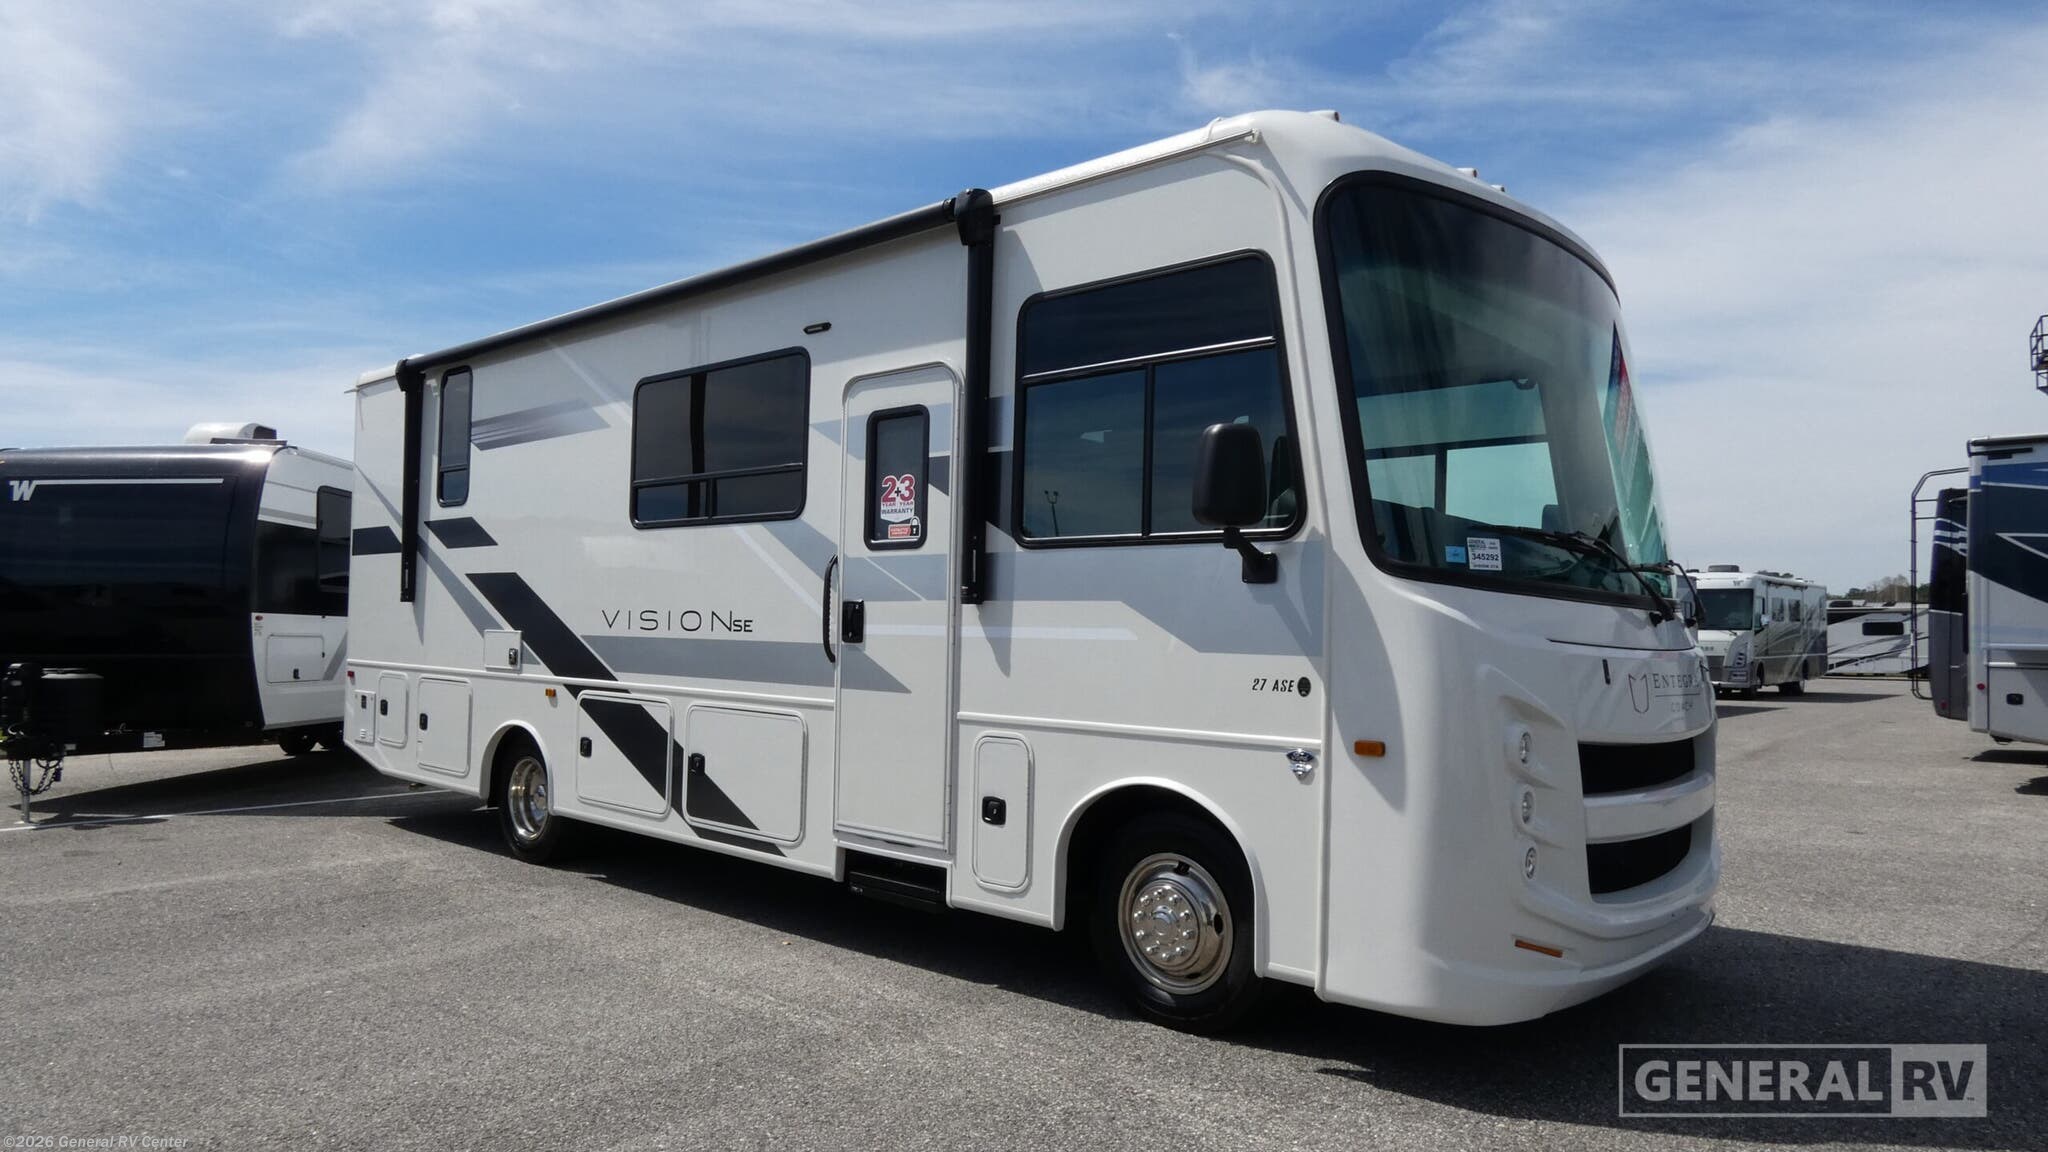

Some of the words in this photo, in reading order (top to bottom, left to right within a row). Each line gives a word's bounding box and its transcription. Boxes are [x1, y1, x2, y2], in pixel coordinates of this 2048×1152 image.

[1472, 553, 1500, 561] 345292
[601, 609, 733, 633] VISION
[733, 619, 753, 633] SE
[1252, 678, 1268, 691] 27
[1272, 679, 1295, 692] ASE
